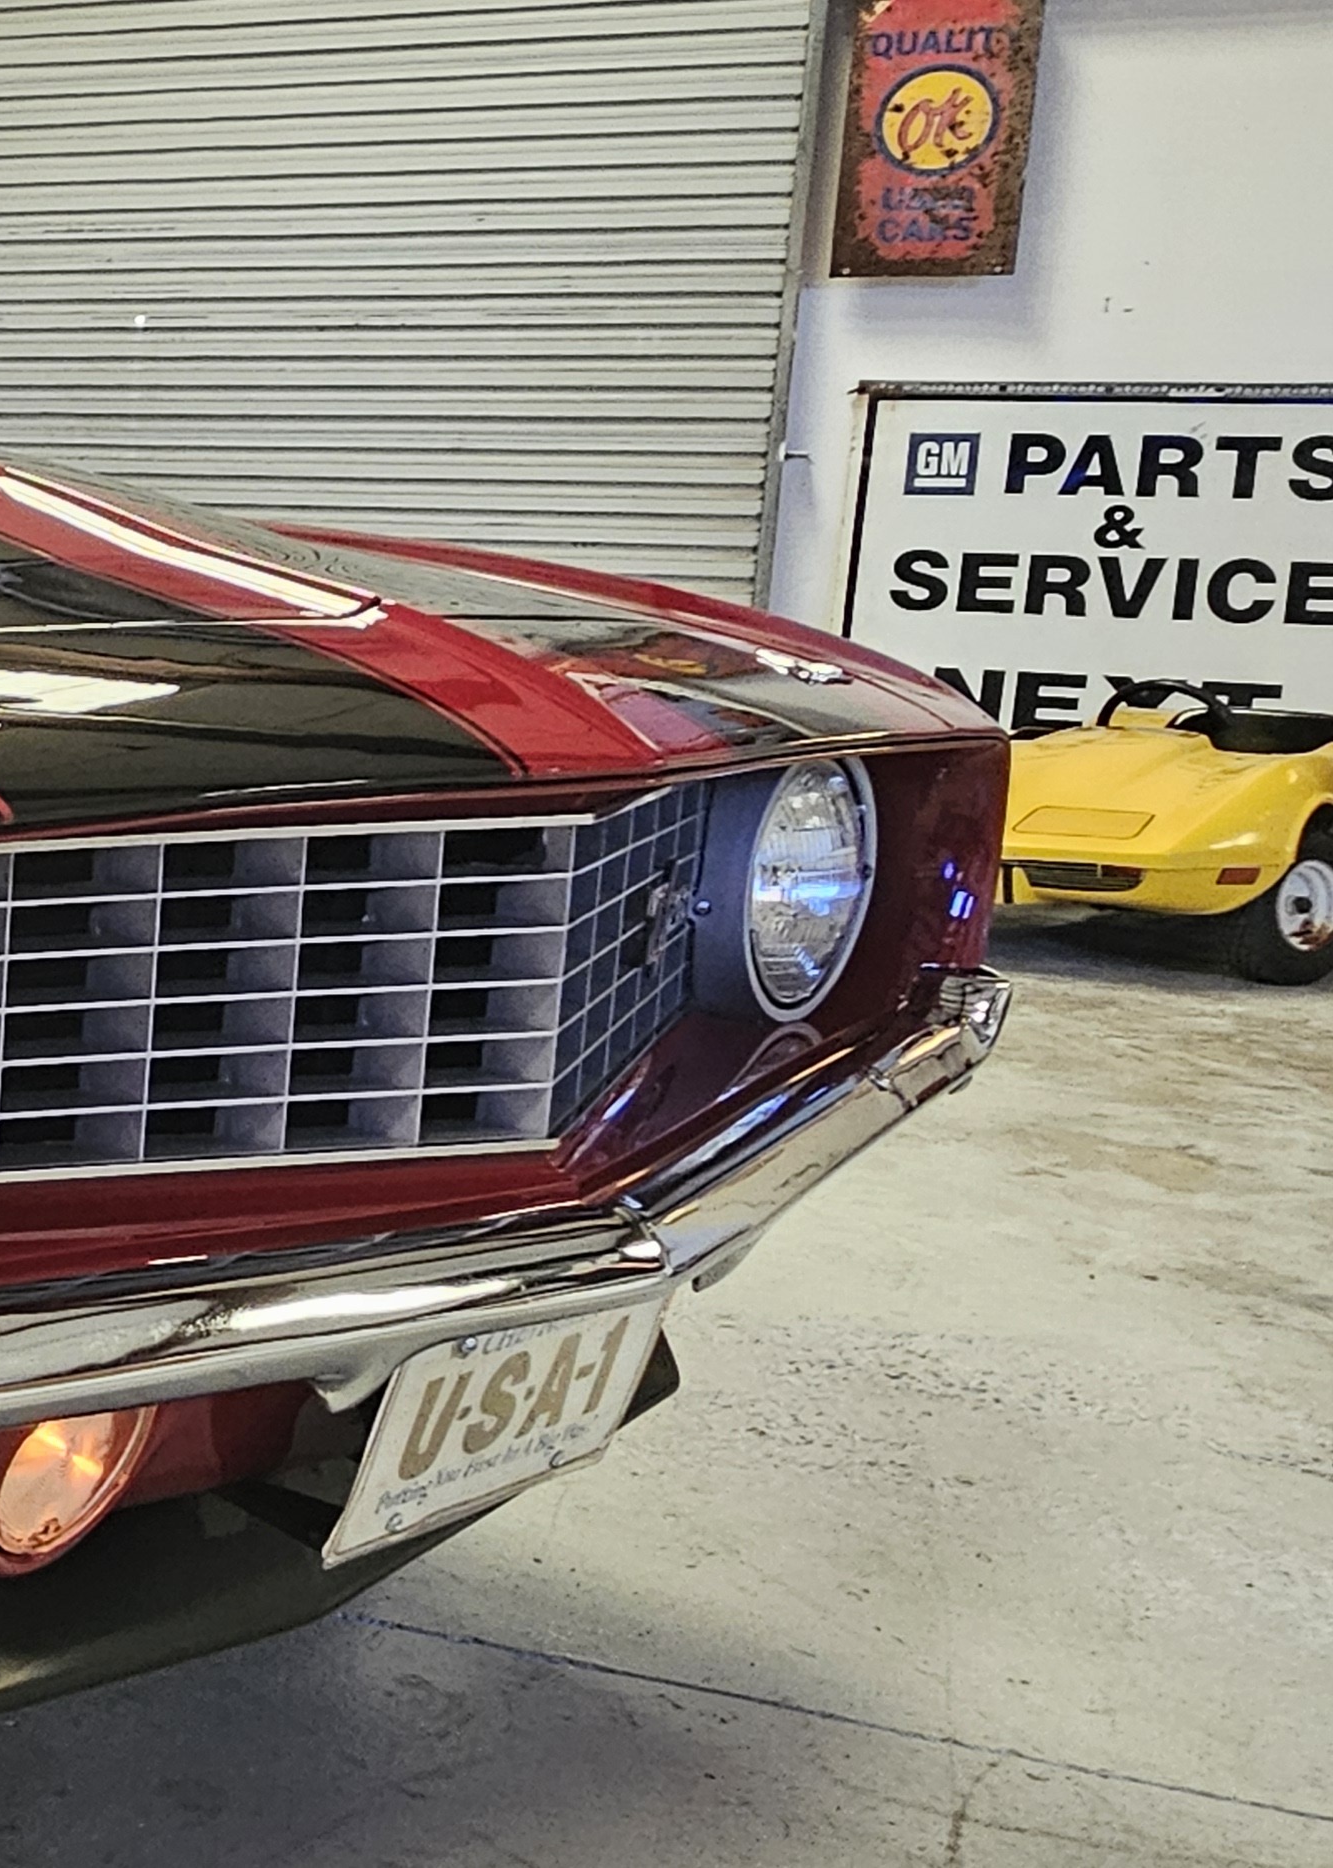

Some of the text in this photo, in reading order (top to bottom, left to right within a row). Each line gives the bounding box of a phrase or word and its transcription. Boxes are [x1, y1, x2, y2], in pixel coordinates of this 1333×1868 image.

[872, 24, 1005, 60] QUALIT
[897, 86, 973, 152] OK
[916, 440, 972, 477] GM
[1004, 432, 1333, 501] PARTS
[1093, 504, 1146, 549] &
[889, 549, 1333, 626] SERVICE
